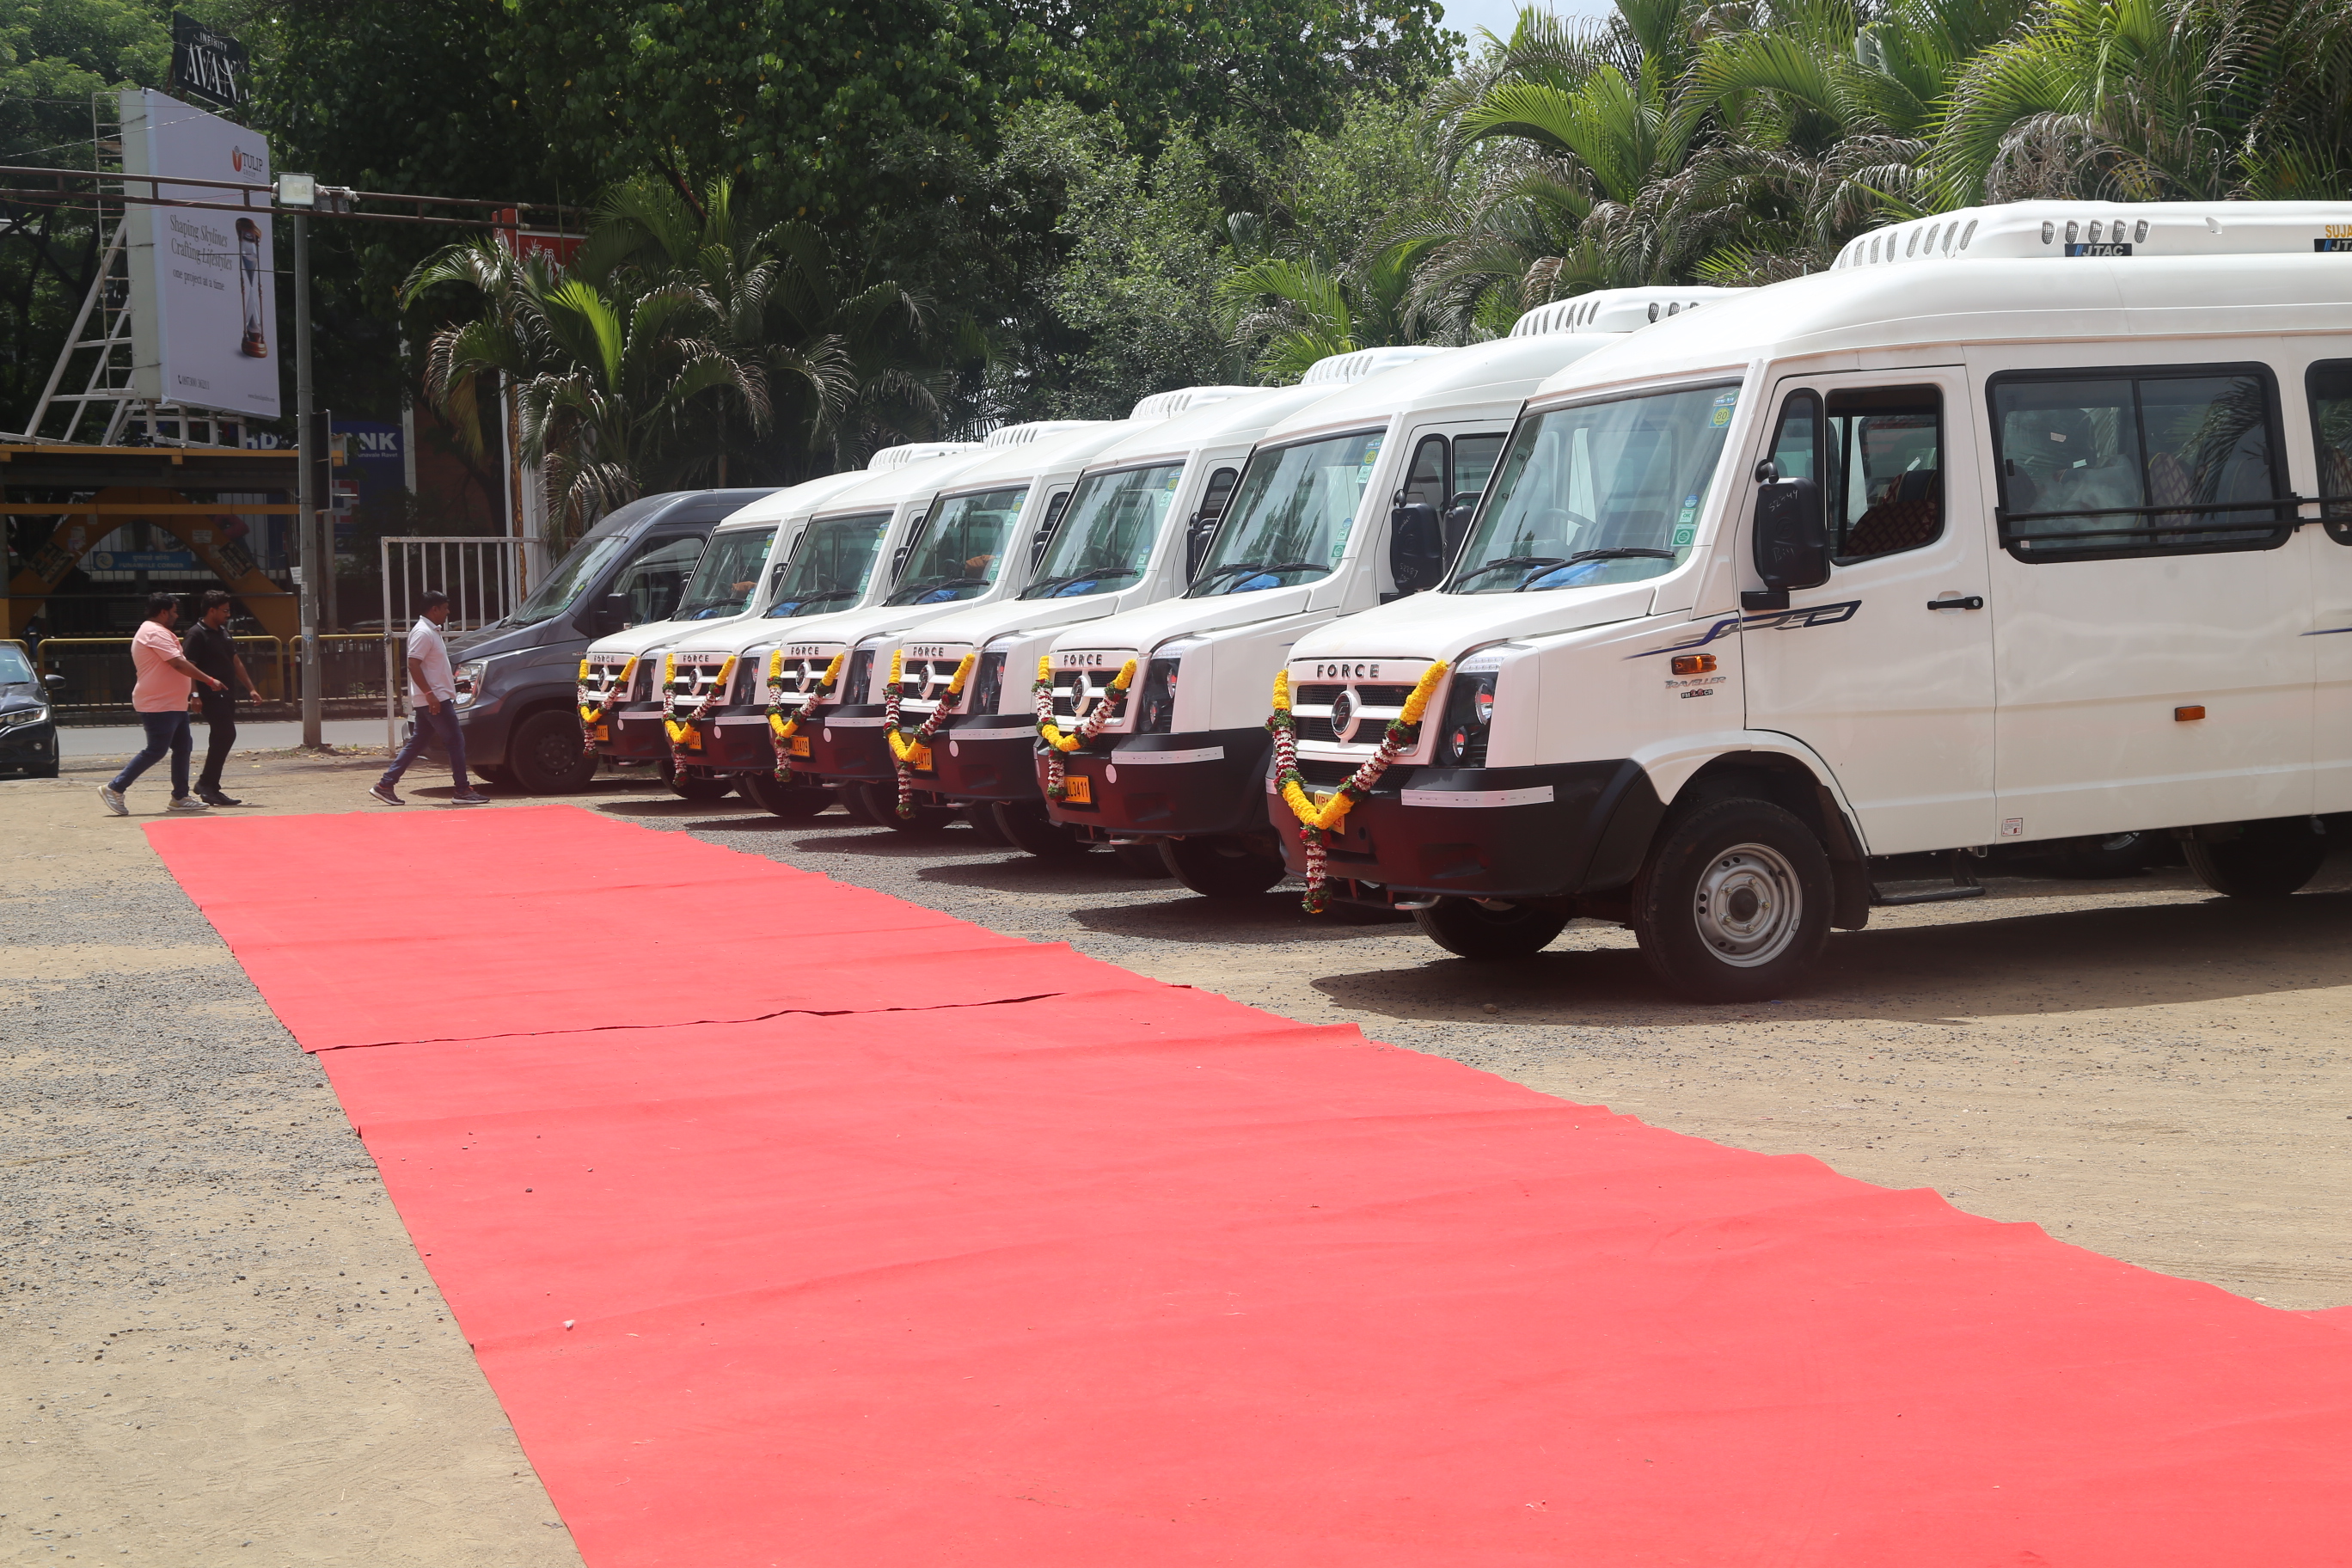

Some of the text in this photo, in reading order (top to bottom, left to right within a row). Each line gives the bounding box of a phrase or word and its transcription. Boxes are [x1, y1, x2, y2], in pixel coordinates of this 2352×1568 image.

[199, 31, 228, 52] INFINITY
[242, 152, 263, 173] TULIP
[170, 214, 228, 248] Shaping Skylines
[171, 237, 232, 271] Crafting Lifestyles
[2082, 245, 2124, 256] JTAC
[173, 268, 183, 279] one
[184, 272, 202, 287] project
[203, 278, 209, 286] at
[213, 279, 225, 291] time
[790, 646, 820, 656] FORCE
[913, 646, 945, 657] FORCE
[593, 654, 615, 663] FORCE
[683, 654, 709, 663] FORCE
[1063, 653, 1103, 666] FORCE
[1316, 664, 1381, 679] FORCE
[1664, 676, 1726, 689] TRAVELLER
